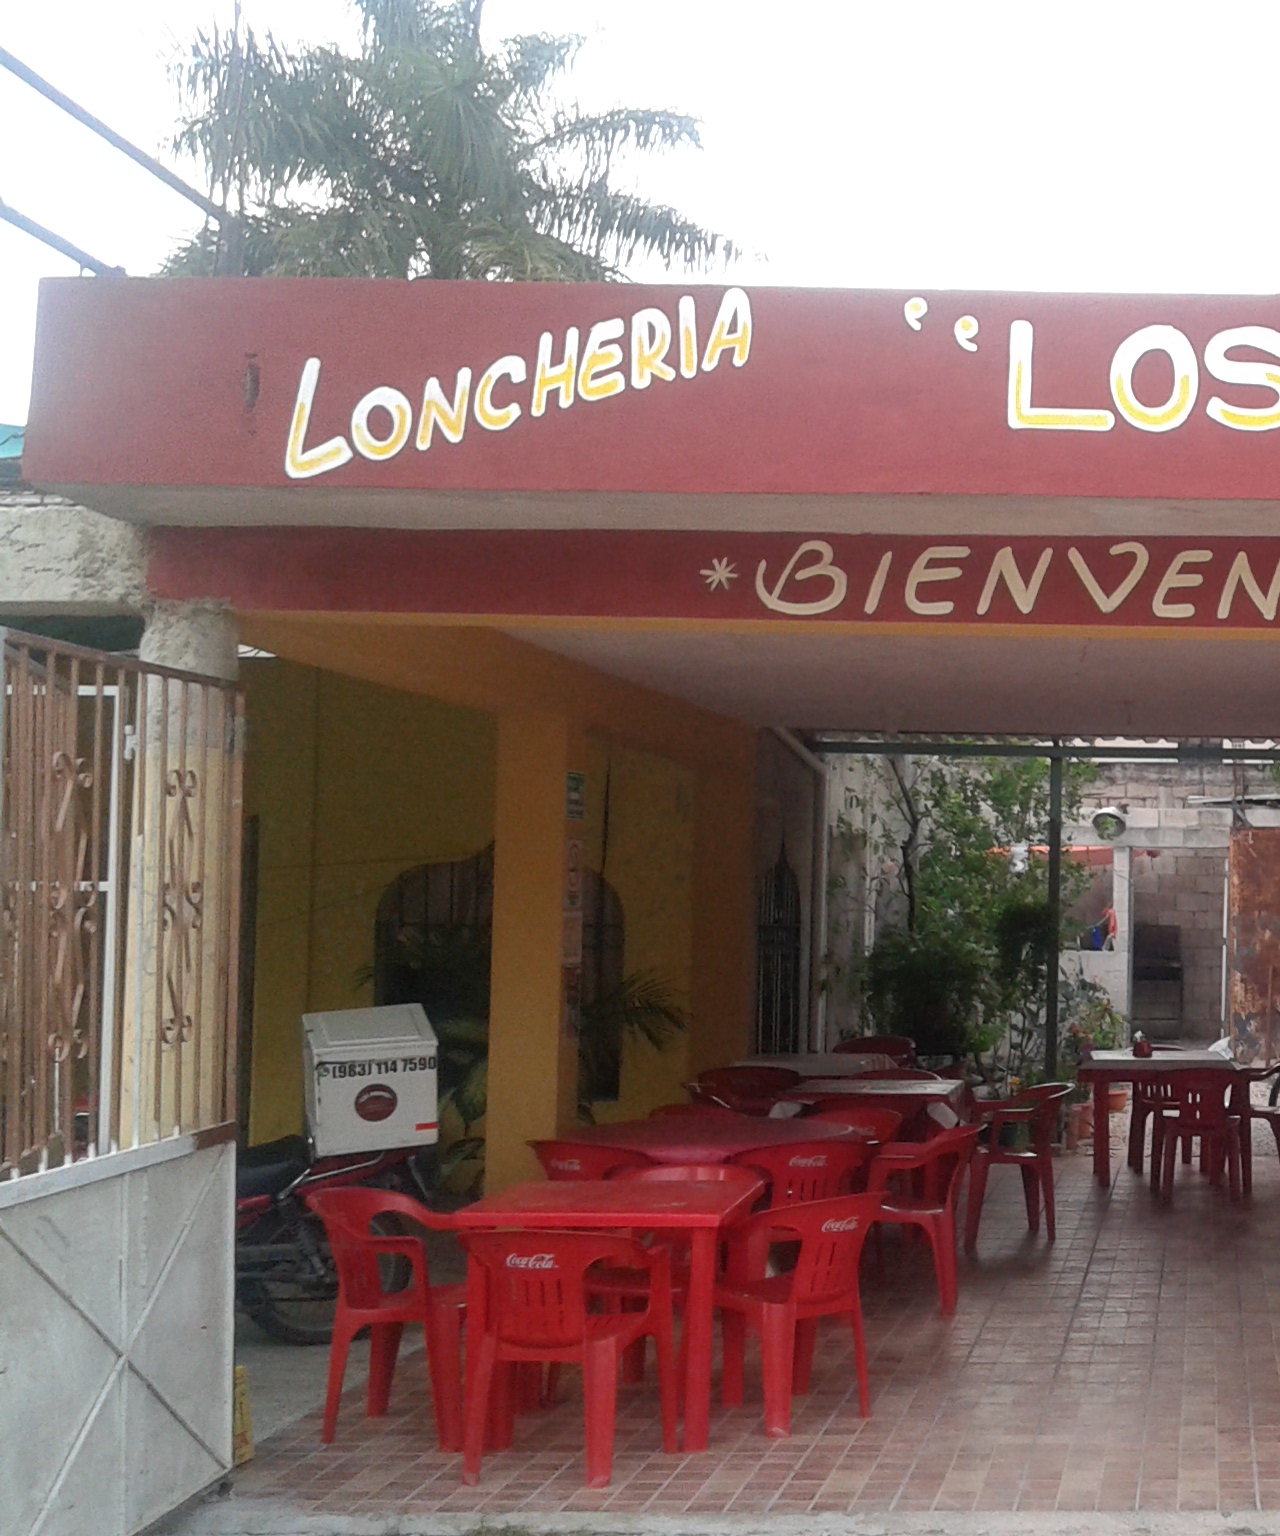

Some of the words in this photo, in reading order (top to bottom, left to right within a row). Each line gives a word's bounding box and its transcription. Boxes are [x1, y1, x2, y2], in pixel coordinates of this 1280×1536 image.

[285, 286, 753, 479] LONCHERIA
[375, 1060, 398, 1075] 114
[402, 1057, 437, 1073] 7590
